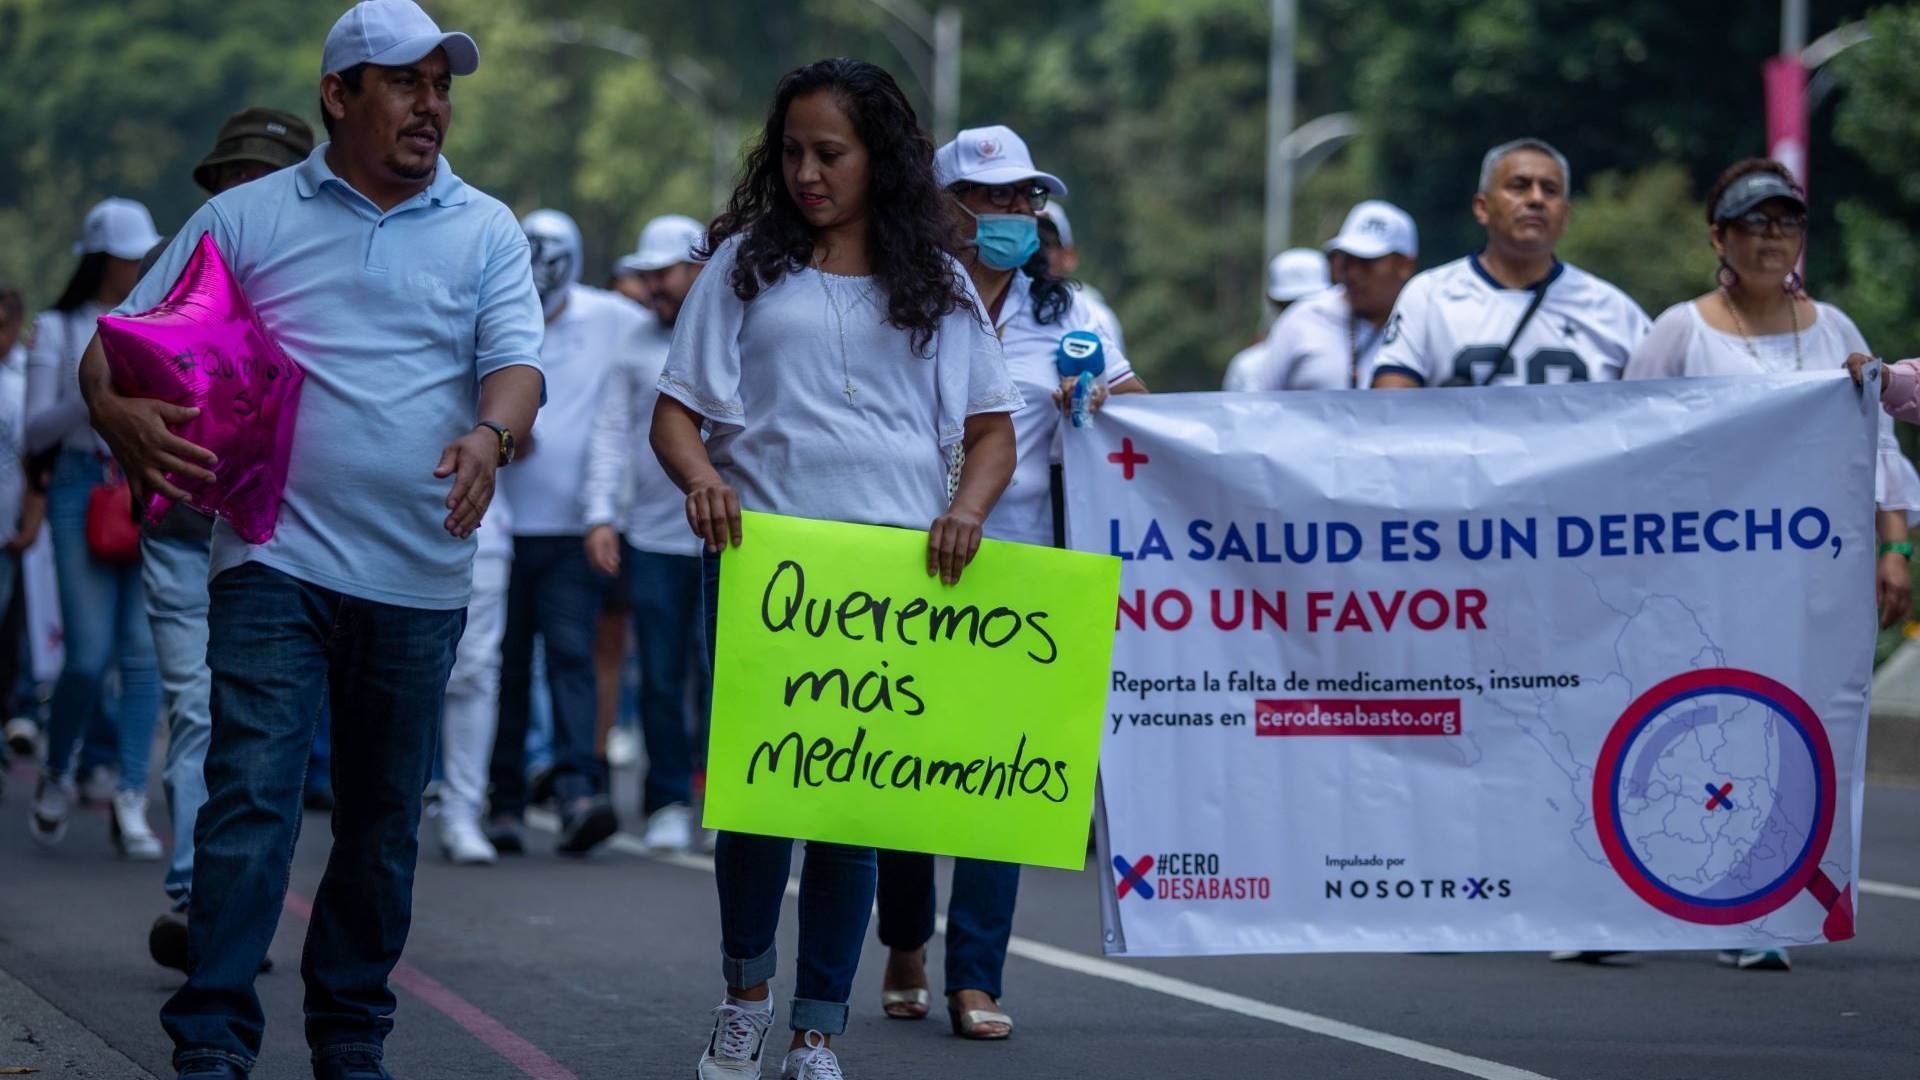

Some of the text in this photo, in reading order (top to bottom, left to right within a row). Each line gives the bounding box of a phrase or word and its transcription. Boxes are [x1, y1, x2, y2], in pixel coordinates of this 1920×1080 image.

[1110, 506, 1843, 564] LA SALUD ES UN DERECHO,
[761, 560, 1058, 664] Queremos
[1115, 588, 1488, 633] NO UN FAVOR
[783, 660, 926, 716] más
[1112, 669, 1581, 700] Reporta la falta de medicamentos, insumos
[1112, 704, 1456, 735] y vacunas en cerodesabasto.org
[1157, 853, 1220, 876] #CERO
[1325, 855, 1406, 870] Impulsado por
[1158, 877, 1271, 900] DESABASTO
